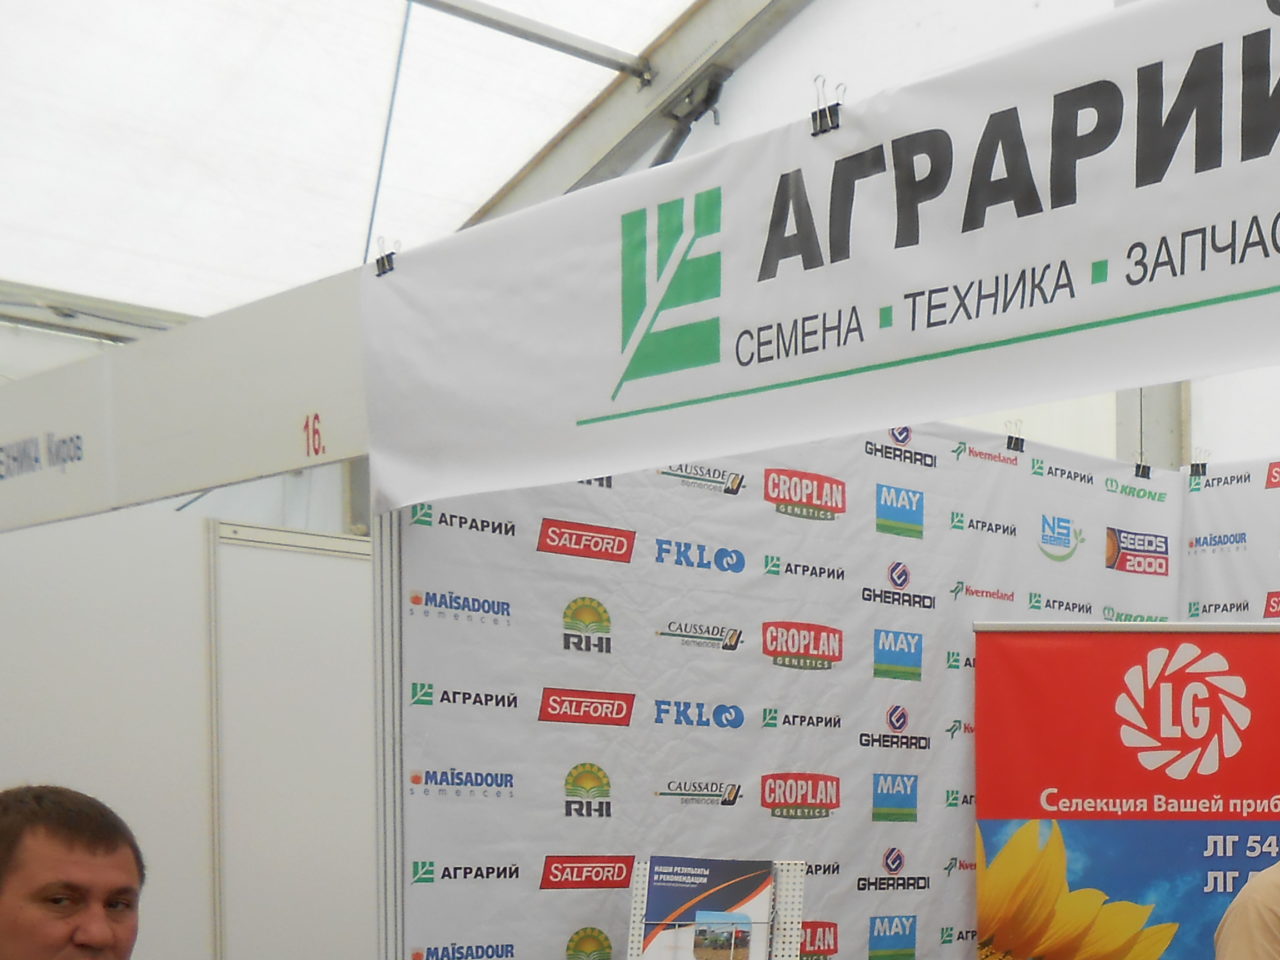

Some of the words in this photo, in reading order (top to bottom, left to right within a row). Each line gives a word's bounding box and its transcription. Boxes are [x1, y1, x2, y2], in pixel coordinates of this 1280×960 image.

[734, 305, 866, 368] СЕМЕНА
[903, 258, 1075, 334] ТЕХНИКА
[864, 440, 936, 468] GHERARDI
[968, 446, 1018, 466] Kverneland
[668, 464, 728, 481] CAUSSADE
[1047, 465, 1094, 485] АГРАРИЙ
[1204, 473, 1251, 489] АГРАРИЙ
[768, 472, 843, 509] CROPLAN
[880, 489, 920, 511] MAY
[1119, 483, 1167, 501] KRONE
[778, 503, 833, 521] GENETICS
[438, 512, 516, 536] АГРАРИЙ
[968, 519, 1017, 536] АГРАРИЙ
[1041, 515, 1071, 537] NS
[546, 527, 628, 555] SALFORD
[1120, 532, 1166, 552] SEEDS
[1193, 532, 1247, 547] MAÏSADOUR
[655, 538, 712, 569] FKL
[784, 562, 846, 581] АГРАРИЙ
[1126, 555, 1166, 573] 2000
[862, 587, 936, 609] GHERARDI
[964, 585, 1014, 601] Kverneland
[424, 591, 511, 617] MAÏSADOUR
[1045, 598, 1092, 614] АГРАРИЙ
[1201, 600, 1249, 615] АГРАРИЙ
[668, 621, 726, 637] CAUSSADE
[563, 632, 612, 654] RHI
[766, 627, 841, 658] CROPLAN
[879, 632, 918, 653] MAY
[775, 656, 831, 671] GENETICS
[440, 691, 518, 708] АГРАРИЙ
[548, 695, 627, 718] SALFORD
[654, 700, 711, 727] FKL
[1160, 681, 1211, 741] LG
[782, 715, 841, 728] АГРАРИЙ
[859, 733, 930, 750] GHERARDI
[424, 769, 514, 788] MAÏSADOUR
[667, 780, 724, 793] CAUSSADE
[877, 776, 916, 794] MAY
[765, 779, 836, 804] CROPLAN
[1040, 786, 1148, 814] Селекция
[1153, 793, 1223, 814] Вашей
[565, 801, 611, 817] RHI
[774, 809, 827, 817] GENETICS
[1203, 835, 1238, 857] ЛГ
[441, 864, 519, 880] АГРАРИЙ
[550, 863, 627, 882] SALFORD
[857, 877, 930, 890] GHERARDI
[1203, 870, 1239, 894] ЛГ
[874, 918, 913, 936] MAY
